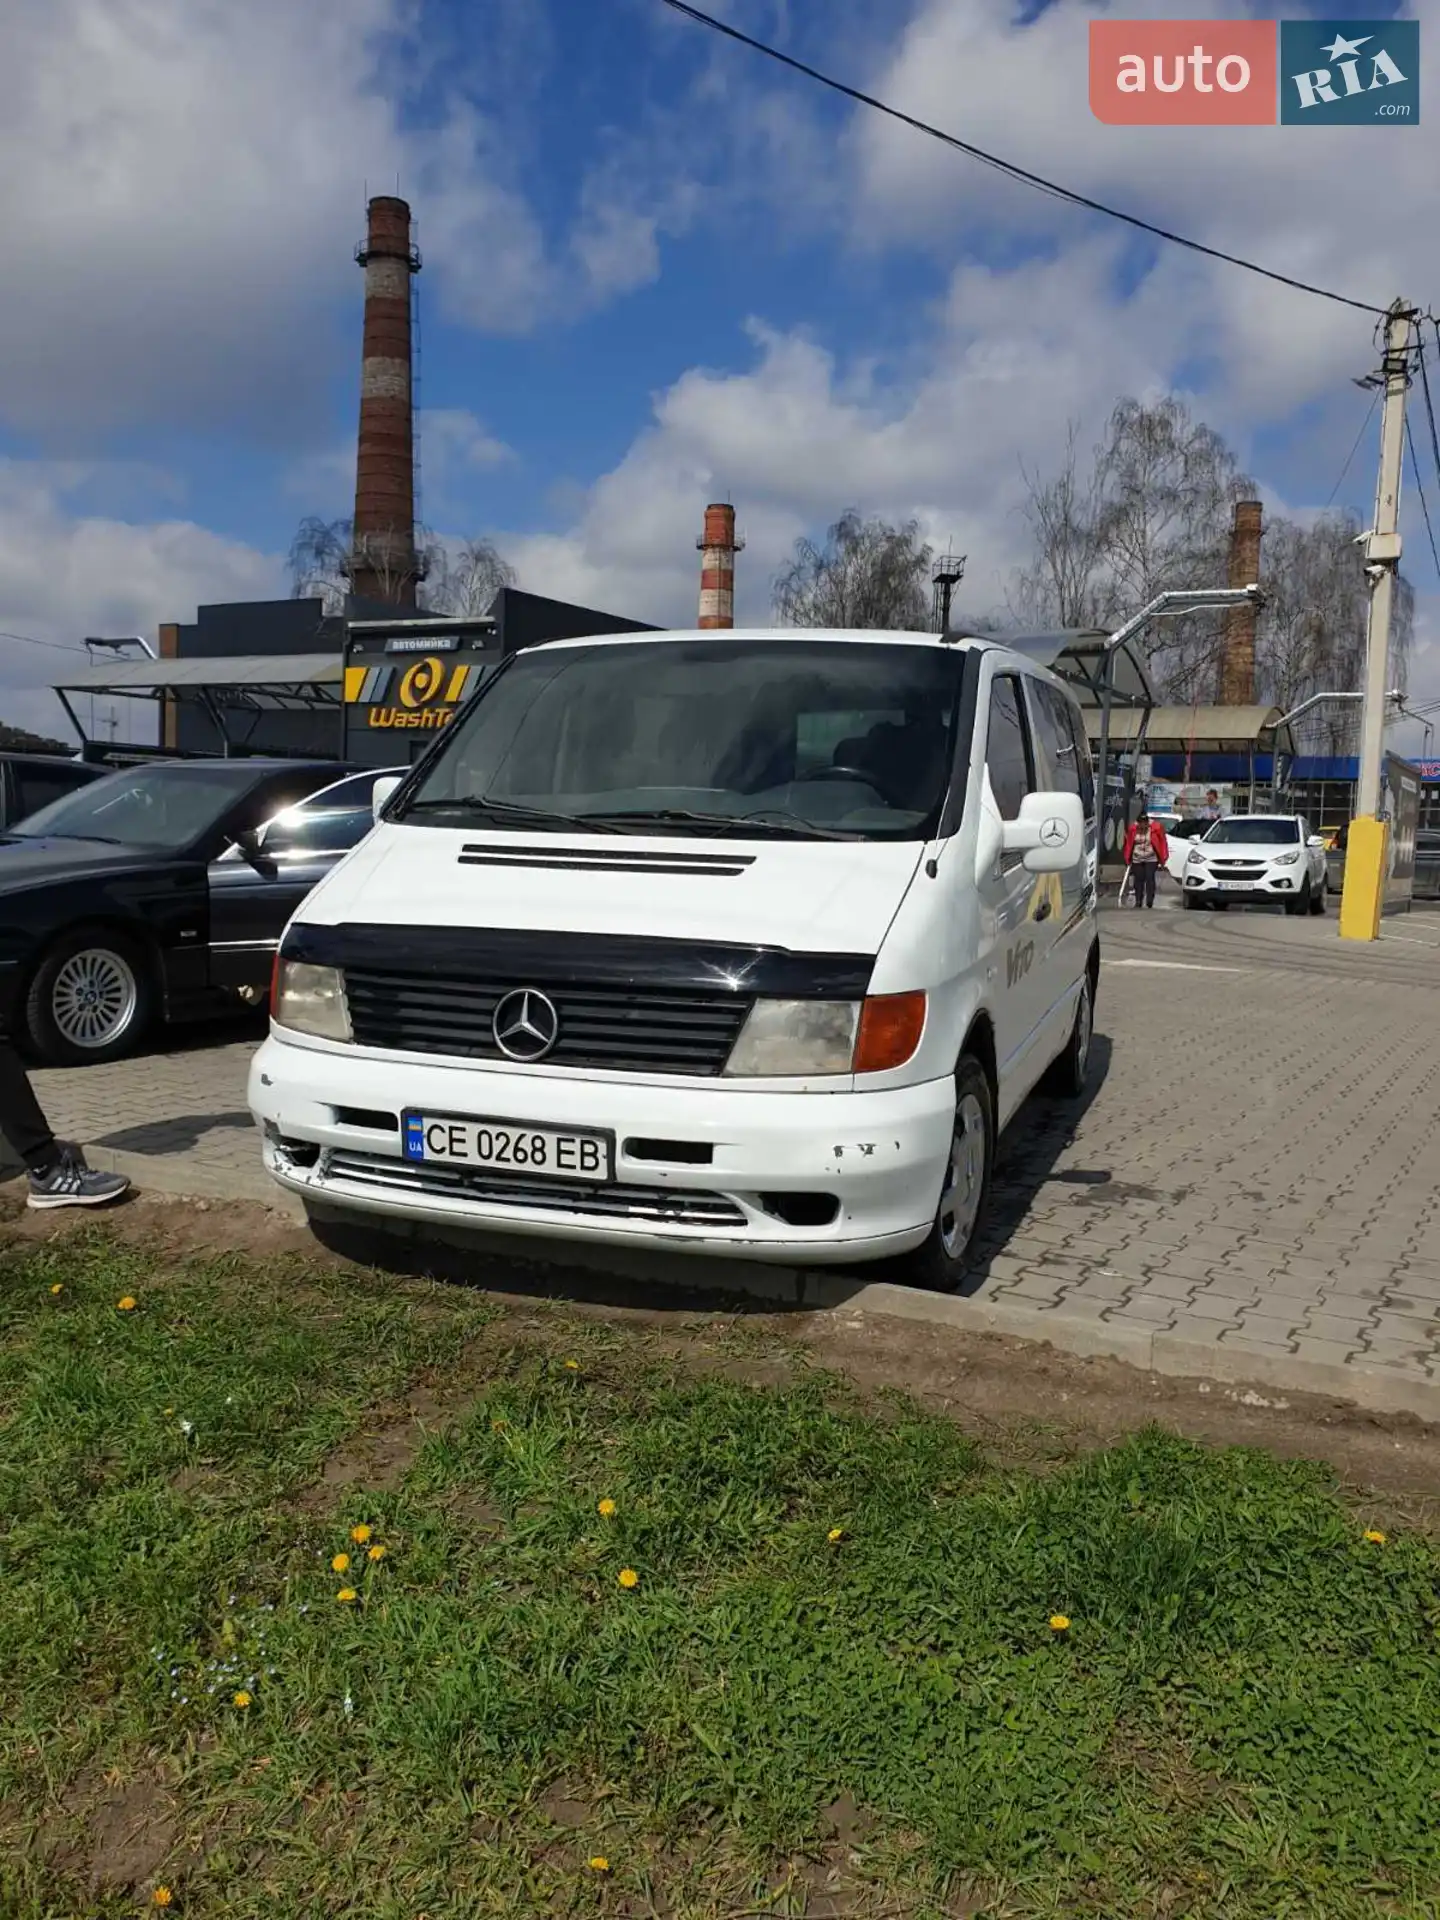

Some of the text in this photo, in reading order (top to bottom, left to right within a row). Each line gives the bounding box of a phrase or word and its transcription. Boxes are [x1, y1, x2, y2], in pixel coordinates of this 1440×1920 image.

[409, 1142, 422, 1153] UA
[426, 1123, 600, 1172] CE 0268 EB
